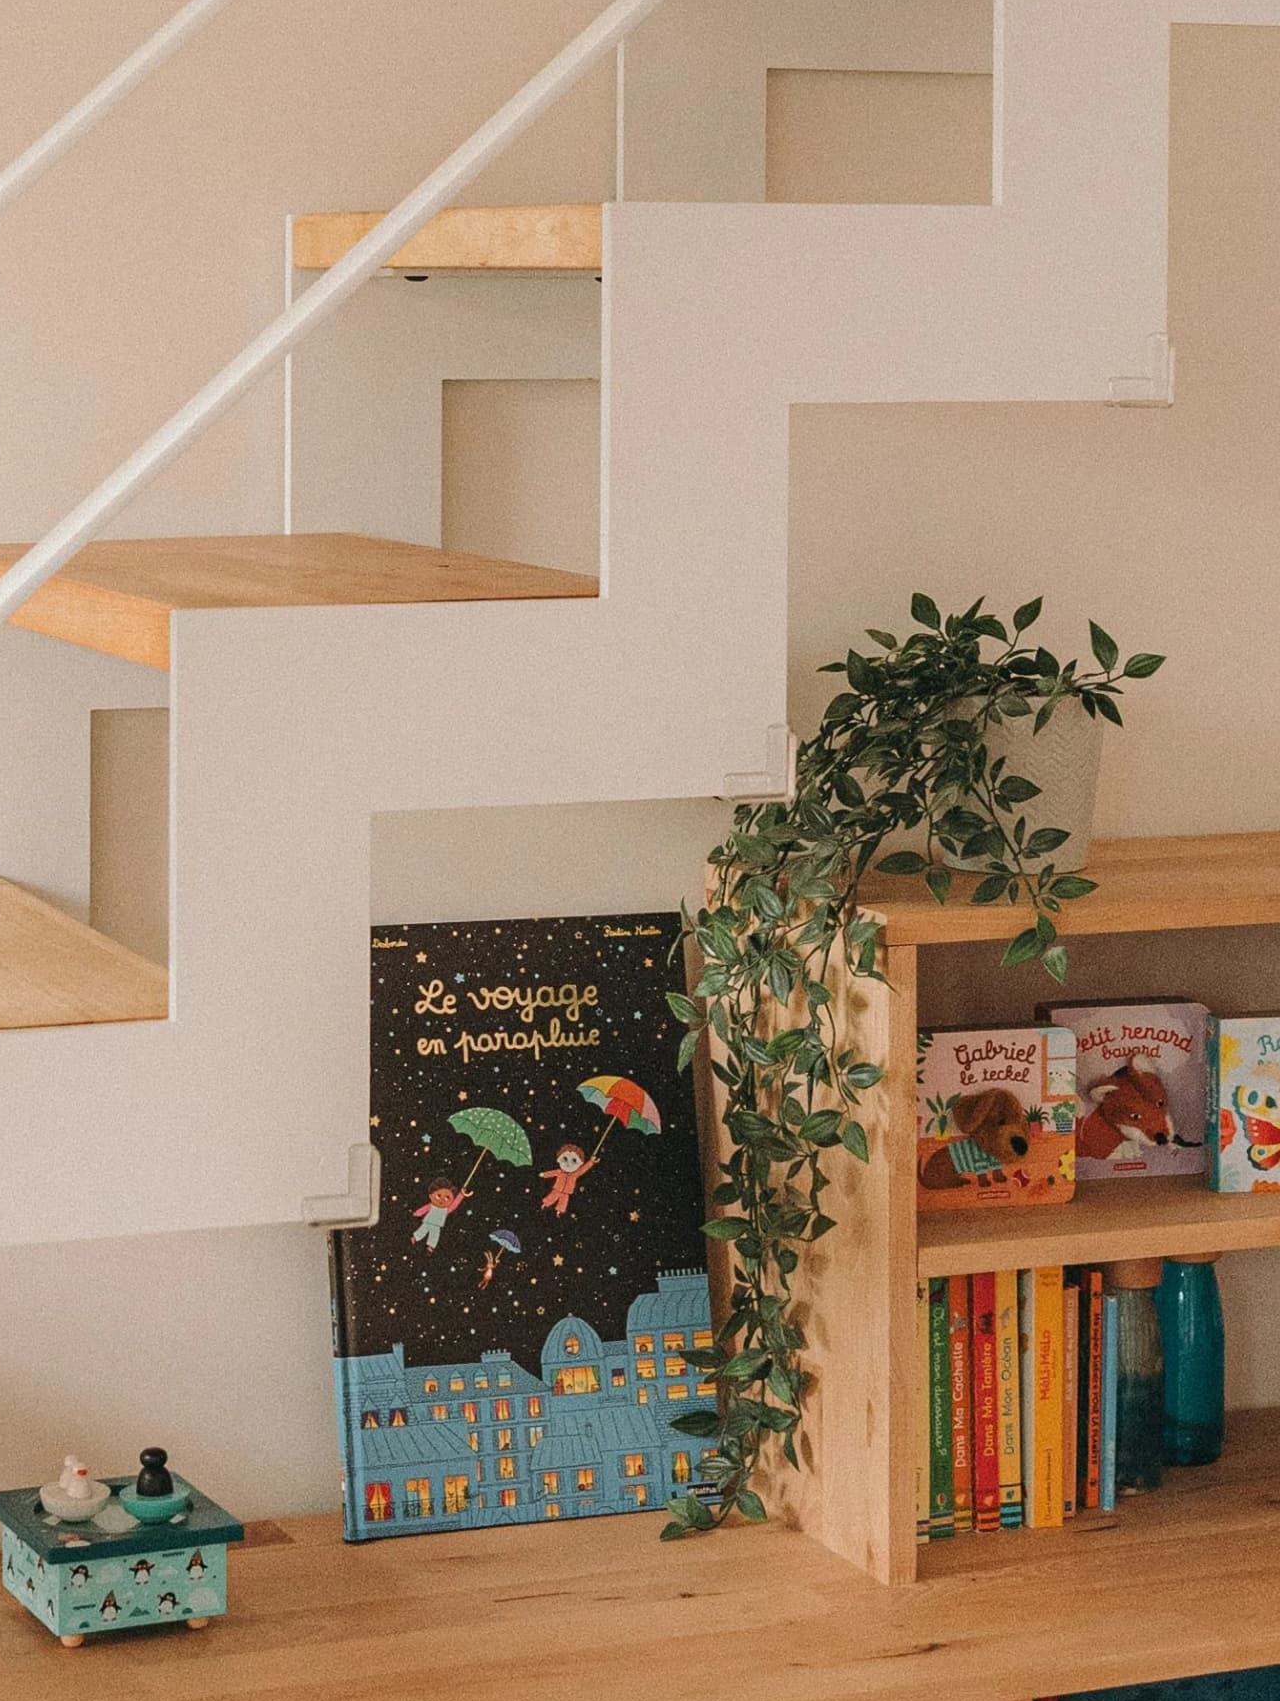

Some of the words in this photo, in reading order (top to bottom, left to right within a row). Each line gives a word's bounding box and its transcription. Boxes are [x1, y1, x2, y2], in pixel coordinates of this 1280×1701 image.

[414, 979, 457, 1015] Le
[467, 984, 599, 1023] voyage
[417, 1037, 447, 1057] en
[453, 1017, 601, 1064] parapluie
[1102, 1045, 1161, 1060] bavard
[1120, 1026, 1194, 1053] renard
[953, 1040, 1037, 1071] Gabriel
[960, 1068, 978, 1086] le
[982, 1067, 1030, 1083] teckel
[933, 1331, 944, 1346] est
[933, 1353, 943, 1380] mon
[952, 1342, 964, 1401] Cachette
[981, 1343, 992, 1390] Tanière
[1000, 1337, 1012, 1381] Océan
[954, 1407, 964, 1429] Ma
[983, 1397, 993, 1418] Ma
[1002, 1388, 1013, 1417] Mon
[955, 1435, 966, 1468] Dans
[984, 1424, 994, 1456] Dans
[1003, 1423, 1014, 1455] Dans
